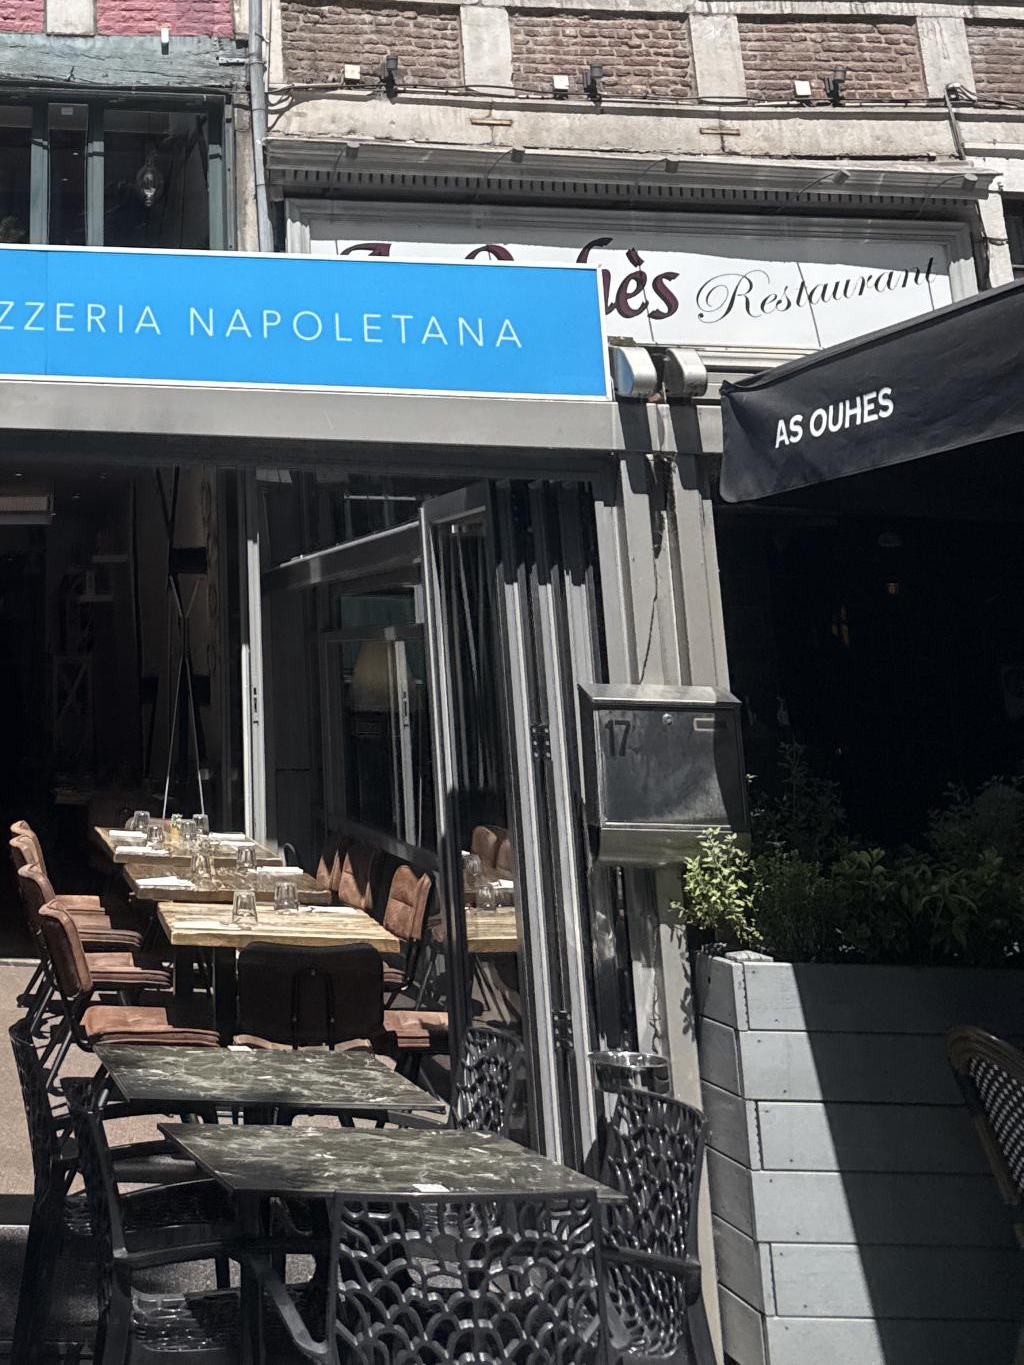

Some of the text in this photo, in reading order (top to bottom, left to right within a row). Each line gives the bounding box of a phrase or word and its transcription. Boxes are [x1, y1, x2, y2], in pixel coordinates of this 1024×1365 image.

[696, 257, 937, 324] Restaurant
[189, 307, 523, 349] NAPOLETANA
[775, 387, 894, 449] AS OUHES
[605, 719, 631, 756] 17
